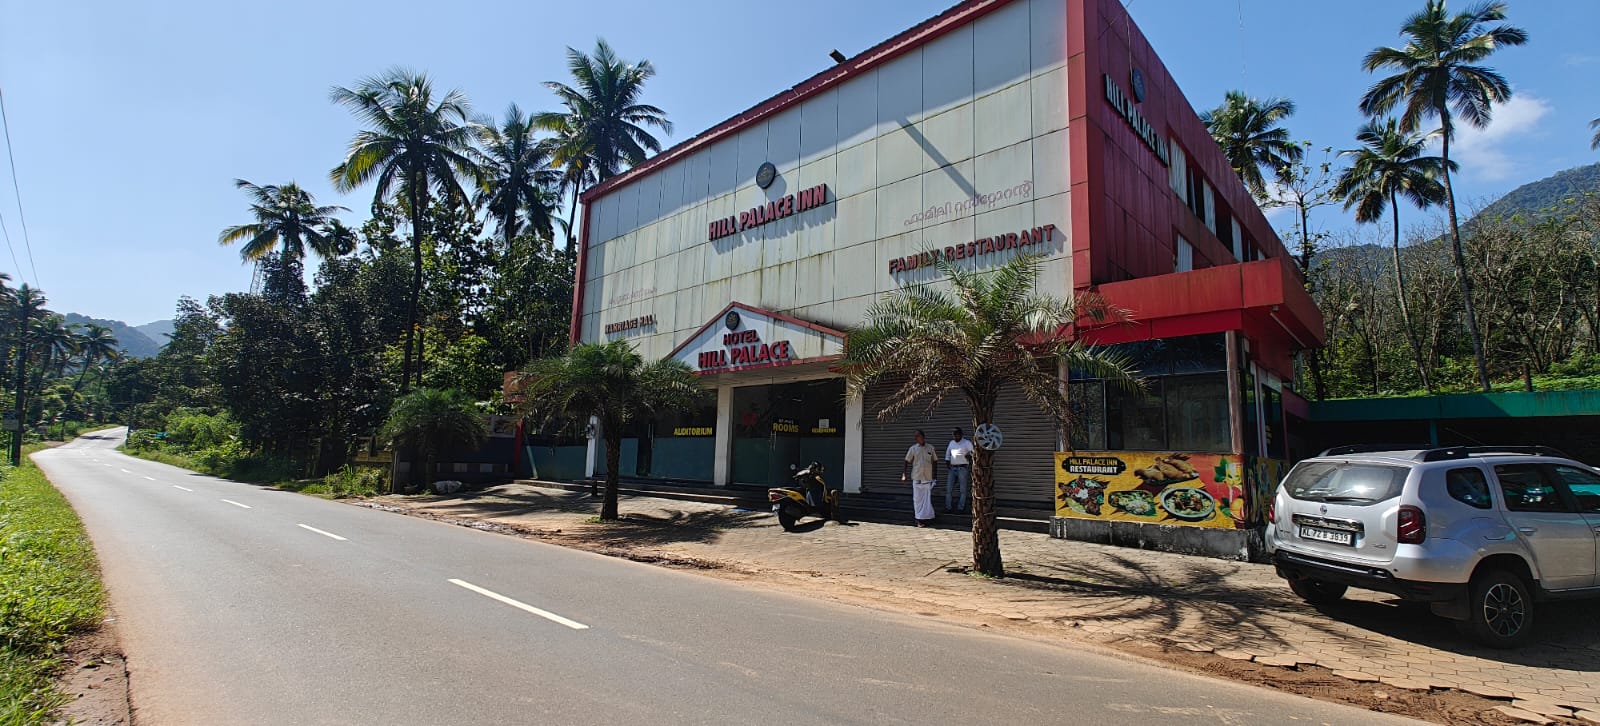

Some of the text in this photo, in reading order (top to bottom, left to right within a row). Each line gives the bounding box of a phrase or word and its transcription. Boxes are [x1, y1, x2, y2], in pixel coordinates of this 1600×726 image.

[1103, 73, 1169, 167] HILL PALACE INN
[709, 183, 827, 240] HILL PALACE INN
[889, 224, 1055, 273] FAMILY RESTAURANT
[723, 329, 759, 346] HOTEL
[698, 340, 790, 368] HILL PALACE
[673, 426, 713, 436] AUDITORIUM
[772, 422, 799, 433] ROOMS
[1302, 527, 1310, 537] KL
